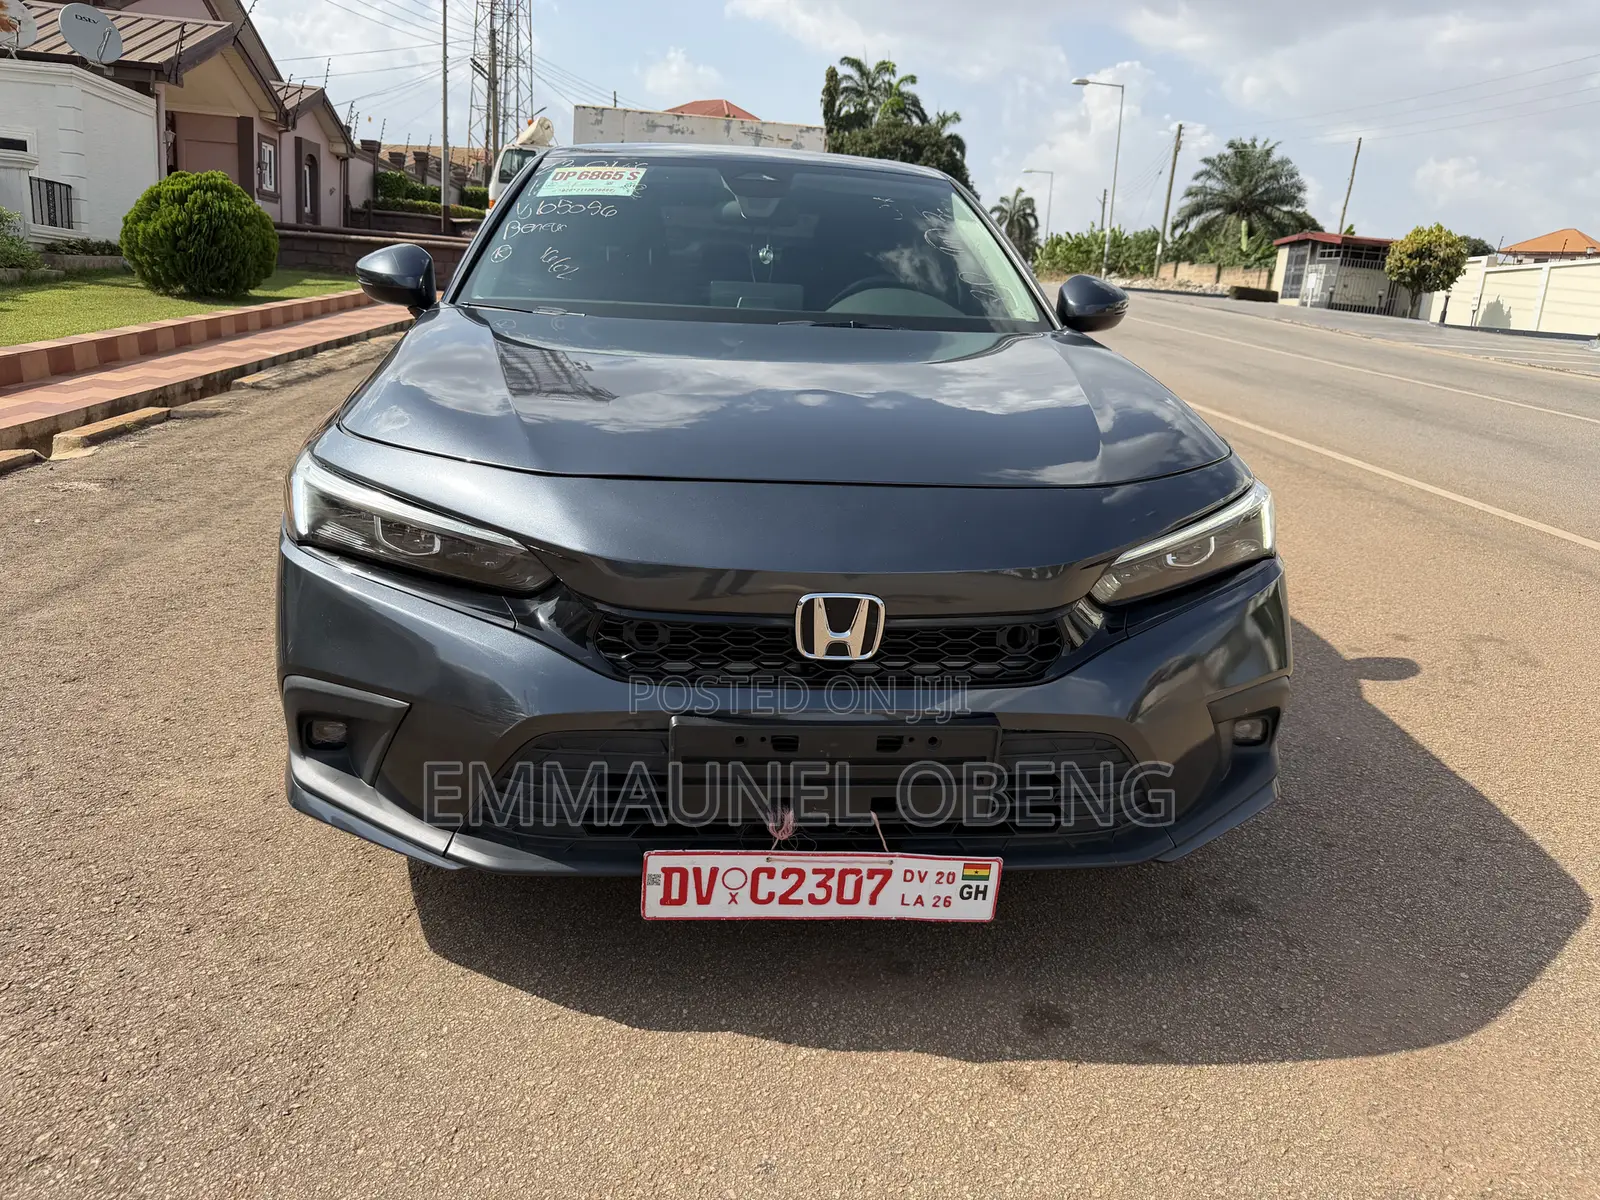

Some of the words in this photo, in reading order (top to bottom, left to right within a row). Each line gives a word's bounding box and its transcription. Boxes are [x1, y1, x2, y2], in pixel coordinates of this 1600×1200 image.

[551, 170, 576, 181] DP
[576, 170, 624, 181] 6865
[626, 171, 641, 181] S
[903, 869, 929, 884] DV
[935, 871, 956, 885] 20
[659, 866, 720, 906] DV
[750, 866, 893, 906] C2307
[959, 884, 989, 901] GH
[900, 893, 925, 907] LA
[932, 895, 952, 908] 26
